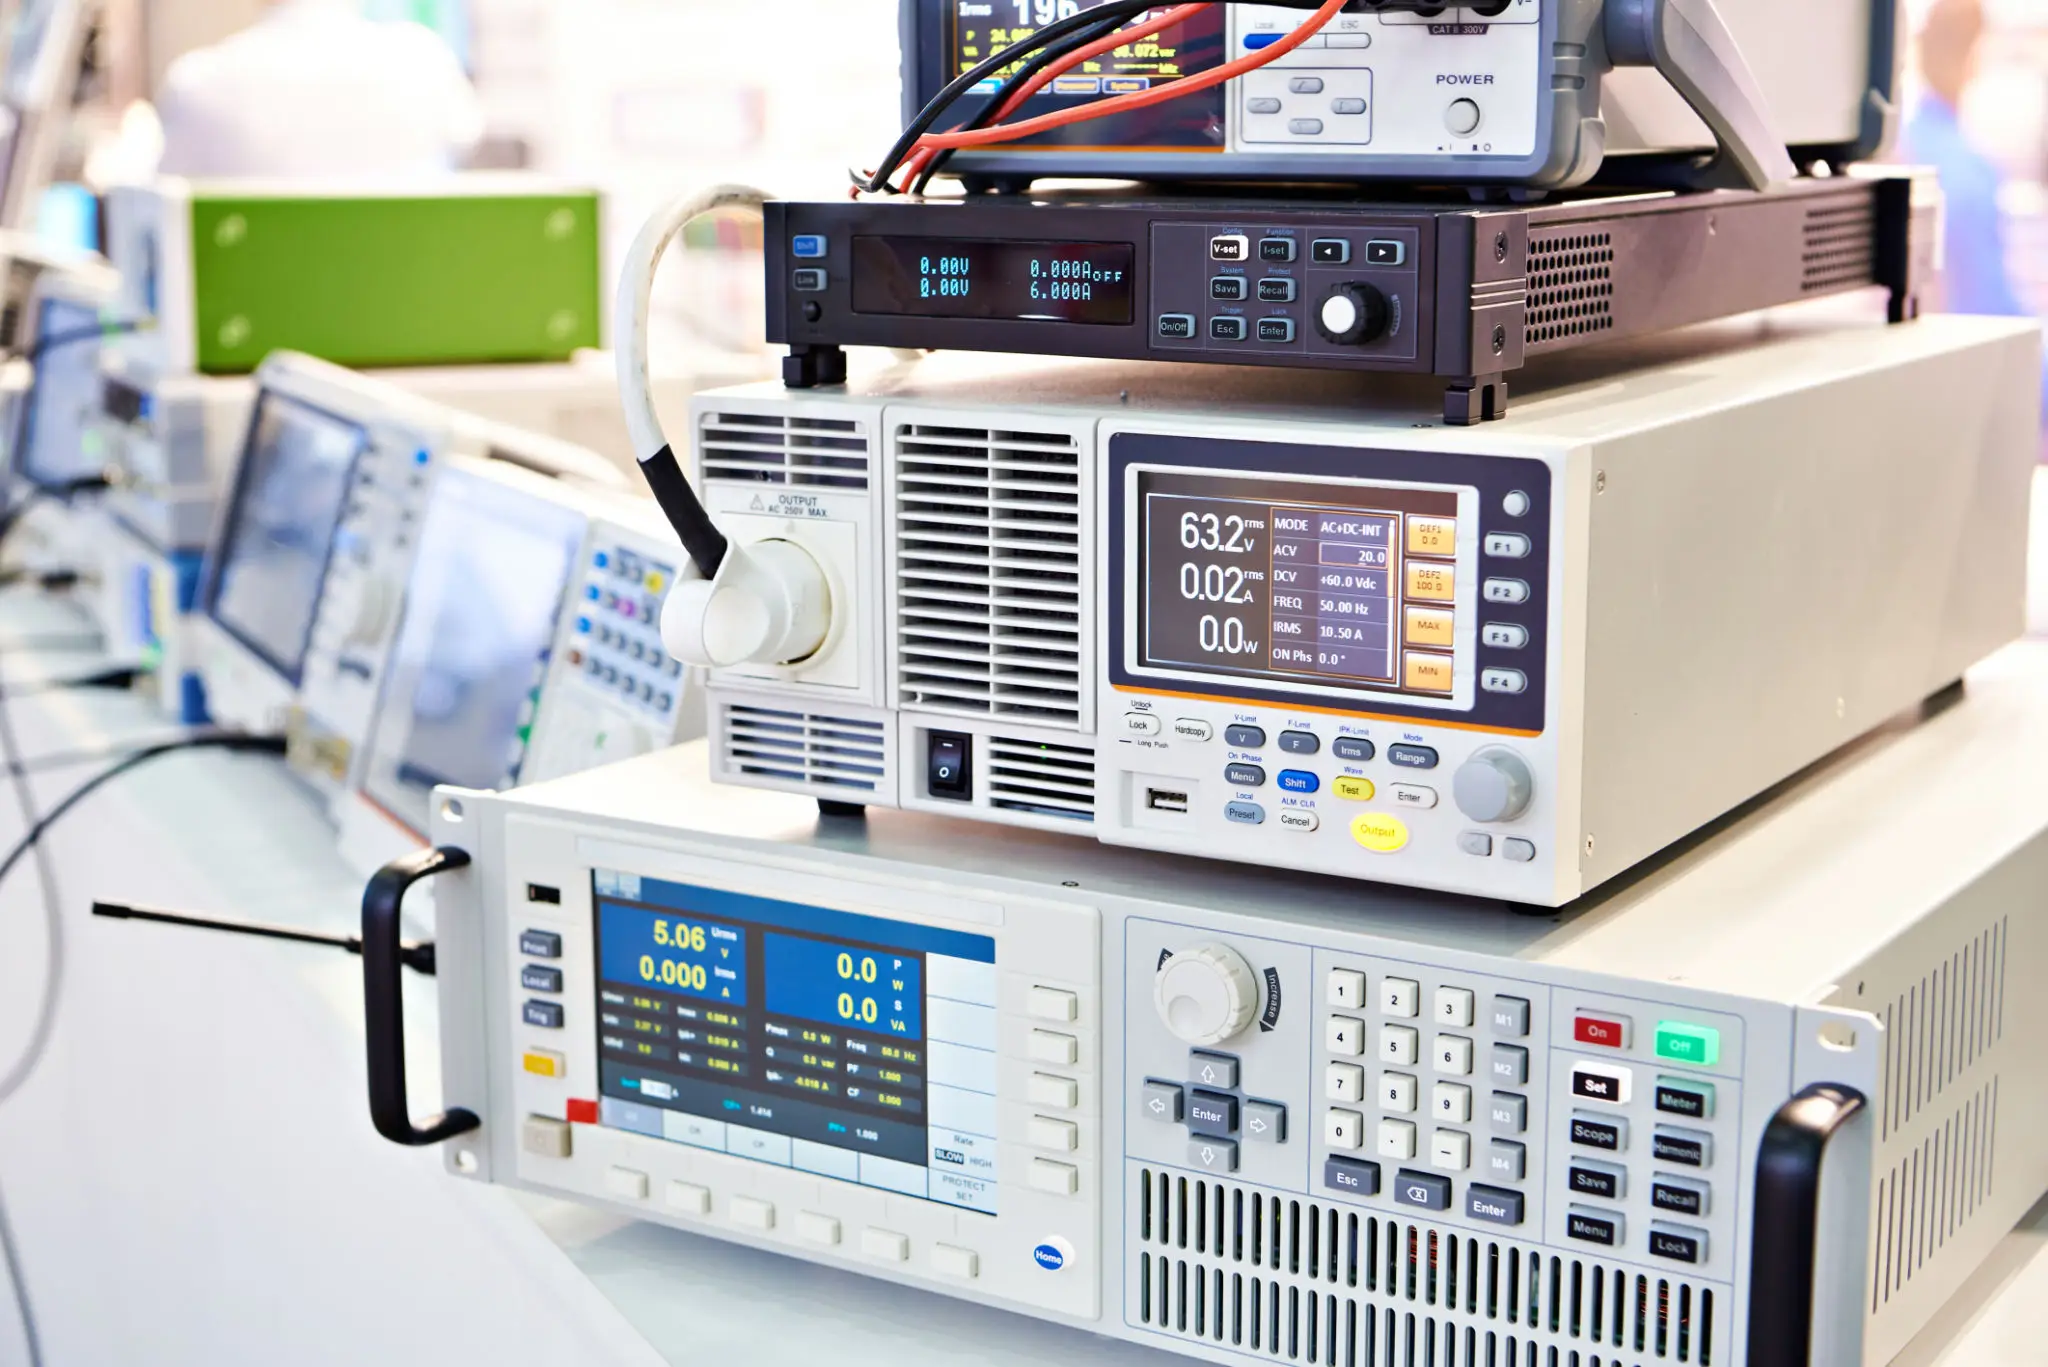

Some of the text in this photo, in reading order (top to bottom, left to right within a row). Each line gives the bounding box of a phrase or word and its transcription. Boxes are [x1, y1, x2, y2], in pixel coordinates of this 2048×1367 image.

[959, 2, 992, 16] Irms
[1341, 20, 1359, 29] ESC
[1432, 26, 1450, 34] CAT
[1464, 26, 1485, 34] 300V
[1435, 74, 1495, 85] POWER
[1214, 244, 1238, 254] V-set
[1264, 246, 1284, 255] I-set
[920, 256, 1091, 279] 0.00V 0.000A
[1221, 266, 1244, 275] System
[1268, 267, 1291, 275] Protect
[1093, 271, 1122, 283] OFF
[920, 278, 1091, 300] 0.00V 6.000A
[1214, 284, 1237, 293] Save
[1260, 285, 1288, 295] Recall
[1160, 321, 1187, 333] On/Off
[1217, 325, 1234, 333] Esc
[1260, 326, 1285, 336] Enter
[778, 495, 818, 506] OUTPUT
[768, 506, 828, 517] AC 250V MAX
[1180, 511, 1265, 553] 63.2 rms
[1274, 517, 1382, 537] MODE AC+DC-INT
[1419, 523, 1442, 534] DEF1
[1244, 538, 1255, 551] V
[1273, 544, 1298, 557] ACV
[1273, 570, 1376, 590] DCV +60.0 Vdc
[1419, 569, 1441, 580] DEF2
[1180, 562, 1264, 604] 0.02 rms
[1243, 590, 1254, 603] A
[1273, 595, 1369, 615] FREQ 50.00 Hz
[1273, 621, 1363, 641] IRMS 10.50 A
[1418, 620, 1440, 631] MAX
[1199, 614, 1258, 654] 0.0 W
[1273, 648, 1290, 661] ON
[1293, 650, 1312, 663] Phs
[1418, 665, 1438, 676] MIN
[1131, 700, 1152, 708] Unlock
[1234, 714, 1257, 723] V-Limit
[1288, 719, 1311, 729] F-Limit
[1129, 720, 1148, 730] Lock
[1175, 725, 1206, 738] Hardcopy
[1403, 733, 1423, 742] Mode
[1137, 739, 1168, 748] Long Push
[1239, 734, 1246, 743] V
[1293, 740, 1299, 749] F
[1228, 752, 1262, 762] On Phase
[1341, 746, 1361, 757] Irms
[1396, 752, 1425, 764] Range
[1231, 771, 1255, 782] Menu
[1344, 766, 1363, 775] Wave
[1285, 777, 1306, 789] Shift
[1340, 784, 1360, 795] Test
[1236, 792, 1253, 800] Local
[1398, 791, 1420, 803] Enter
[1281, 798, 1316, 808] ALM CLR
[1229, 808, 1255, 820] Preset
[1281, 815, 1310, 827] Cancel
[1360, 824, 1395, 838] Output
[653, 919, 706, 952] 5.06
[721, 948, 729, 959] V
[639, 955, 706, 991] 0.000
[837, 953, 902, 983] 0.0 P
[524, 972, 550, 987] Local
[892, 980, 904, 991] W
[721, 986, 730, 998] A
[1268, 973, 1278, 1018] Increase
[1338, 986, 1344, 996] 1
[1392, 995, 1398, 1005] 2
[837, 993, 902, 1023] 0.0 S
[1446, 1004, 1452, 1014] 3
[528, 1009, 548, 1025] Trig
[1496, 1014, 1512, 1027] M1
[891, 1018, 906, 1032] VA
[1337, 1033, 1344, 1042] 4
[1588, 1025, 1608, 1038] On
[1391, 1042, 1397, 1052] 5
[1669, 1039, 1691, 1053] Off
[1444, 1052, 1451, 1062] 6
[1494, 1063, 1511, 1076] M2
[1337, 1080, 1343, 1089] 7
[1585, 1079, 1608, 1094] Set
[1390, 1090, 1397, 1099] 8
[1443, 1100, 1450, 1110] 9
[1661, 1093, 1697, 1111] Meter
[1192, 1107, 1222, 1123] Enter
[1493, 1110, 1511, 1123] M3
[1336, 1127, 1342, 1137] 0
[1574, 1121, 1614, 1144] Scope
[954, 1134, 974, 1146] Rate
[935, 1149, 992, 1169] SLOW HIGH
[1492, 1158, 1510, 1171] M4
[942, 1175, 985, 1191] PROTECT
[1336, 1172, 1358, 1187] Esc
[1577, 1174, 1608, 1190] Save
[956, 1191, 973, 1201] SET
[1656, 1190, 1697, 1208] Recall
[1473, 1201, 1506, 1218] Enter
[1573, 1221, 1608, 1238] Menu
[1658, 1238, 1689, 1255] Lock
[1036, 1250, 1062, 1265] Home
